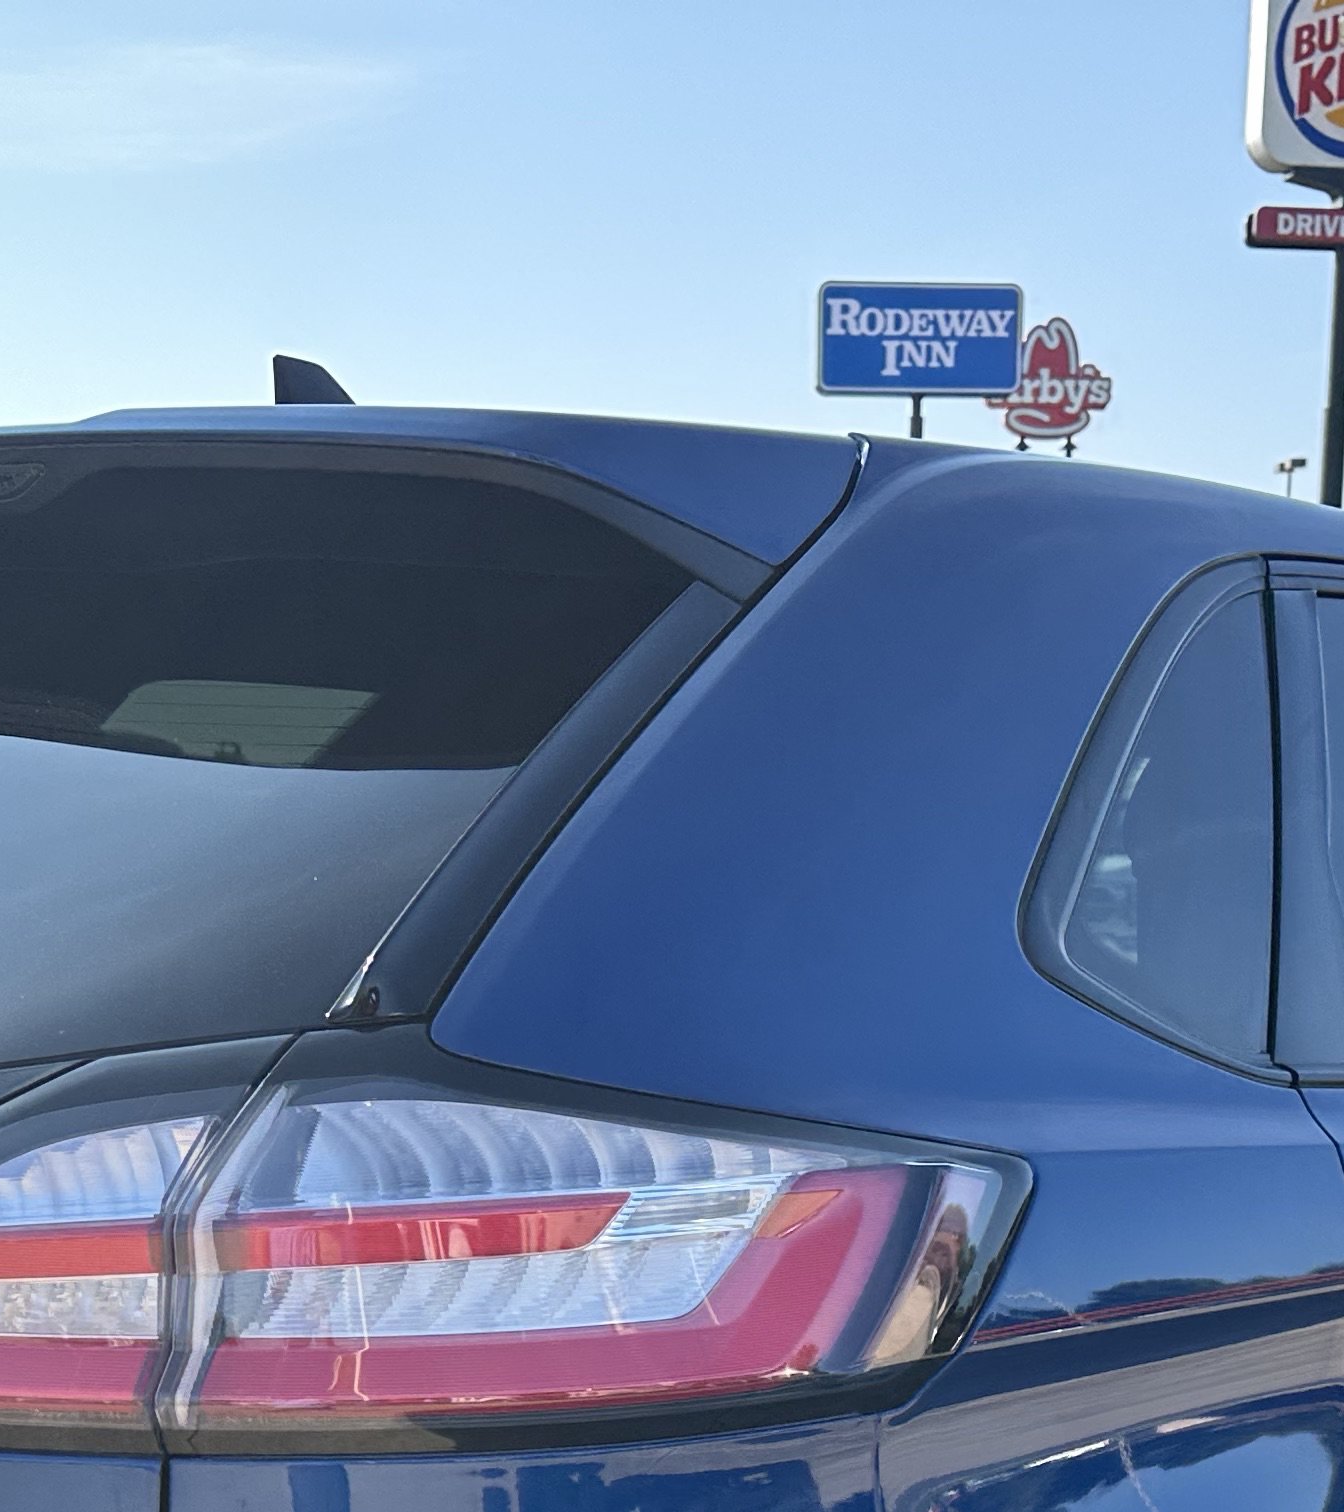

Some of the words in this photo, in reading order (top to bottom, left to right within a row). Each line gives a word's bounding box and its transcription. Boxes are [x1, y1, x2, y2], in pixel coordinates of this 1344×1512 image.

[825, 298, 1015, 338] RODEWAY
[880, 339, 958, 377] INN
[1007, 366, 1111, 414] rby's
